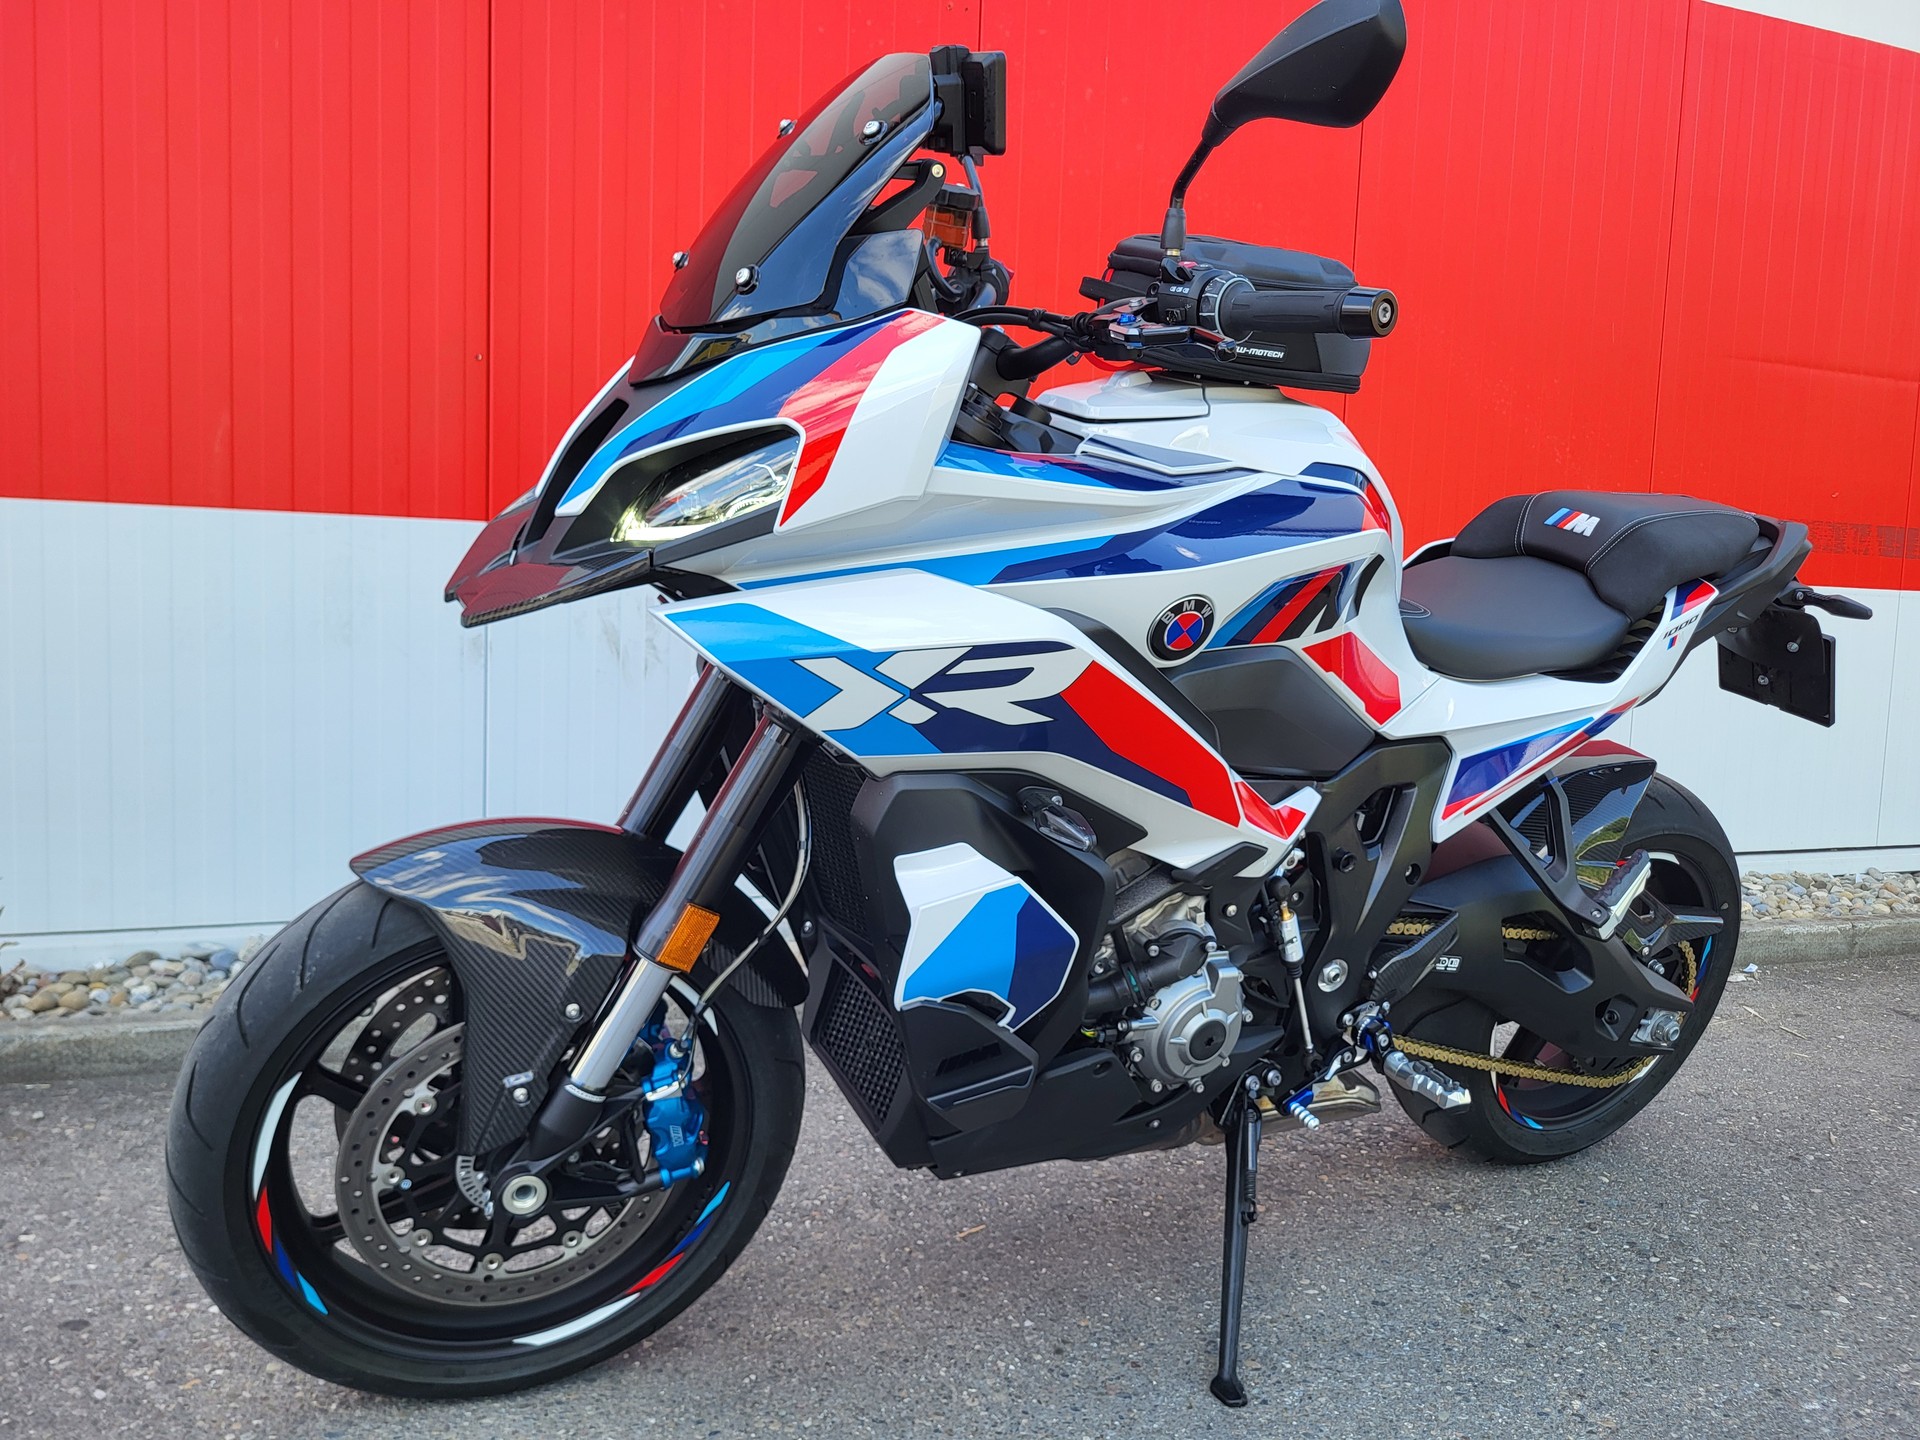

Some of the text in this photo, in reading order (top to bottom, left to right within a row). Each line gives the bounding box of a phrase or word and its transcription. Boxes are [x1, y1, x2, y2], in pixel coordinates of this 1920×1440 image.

[1236, 346, 1284, 359] W-MOTECH
[1160, 599, 1214, 625] BMW
[1663, 614, 1699, 640] 1000
[789, 645, 1095, 732] XR
